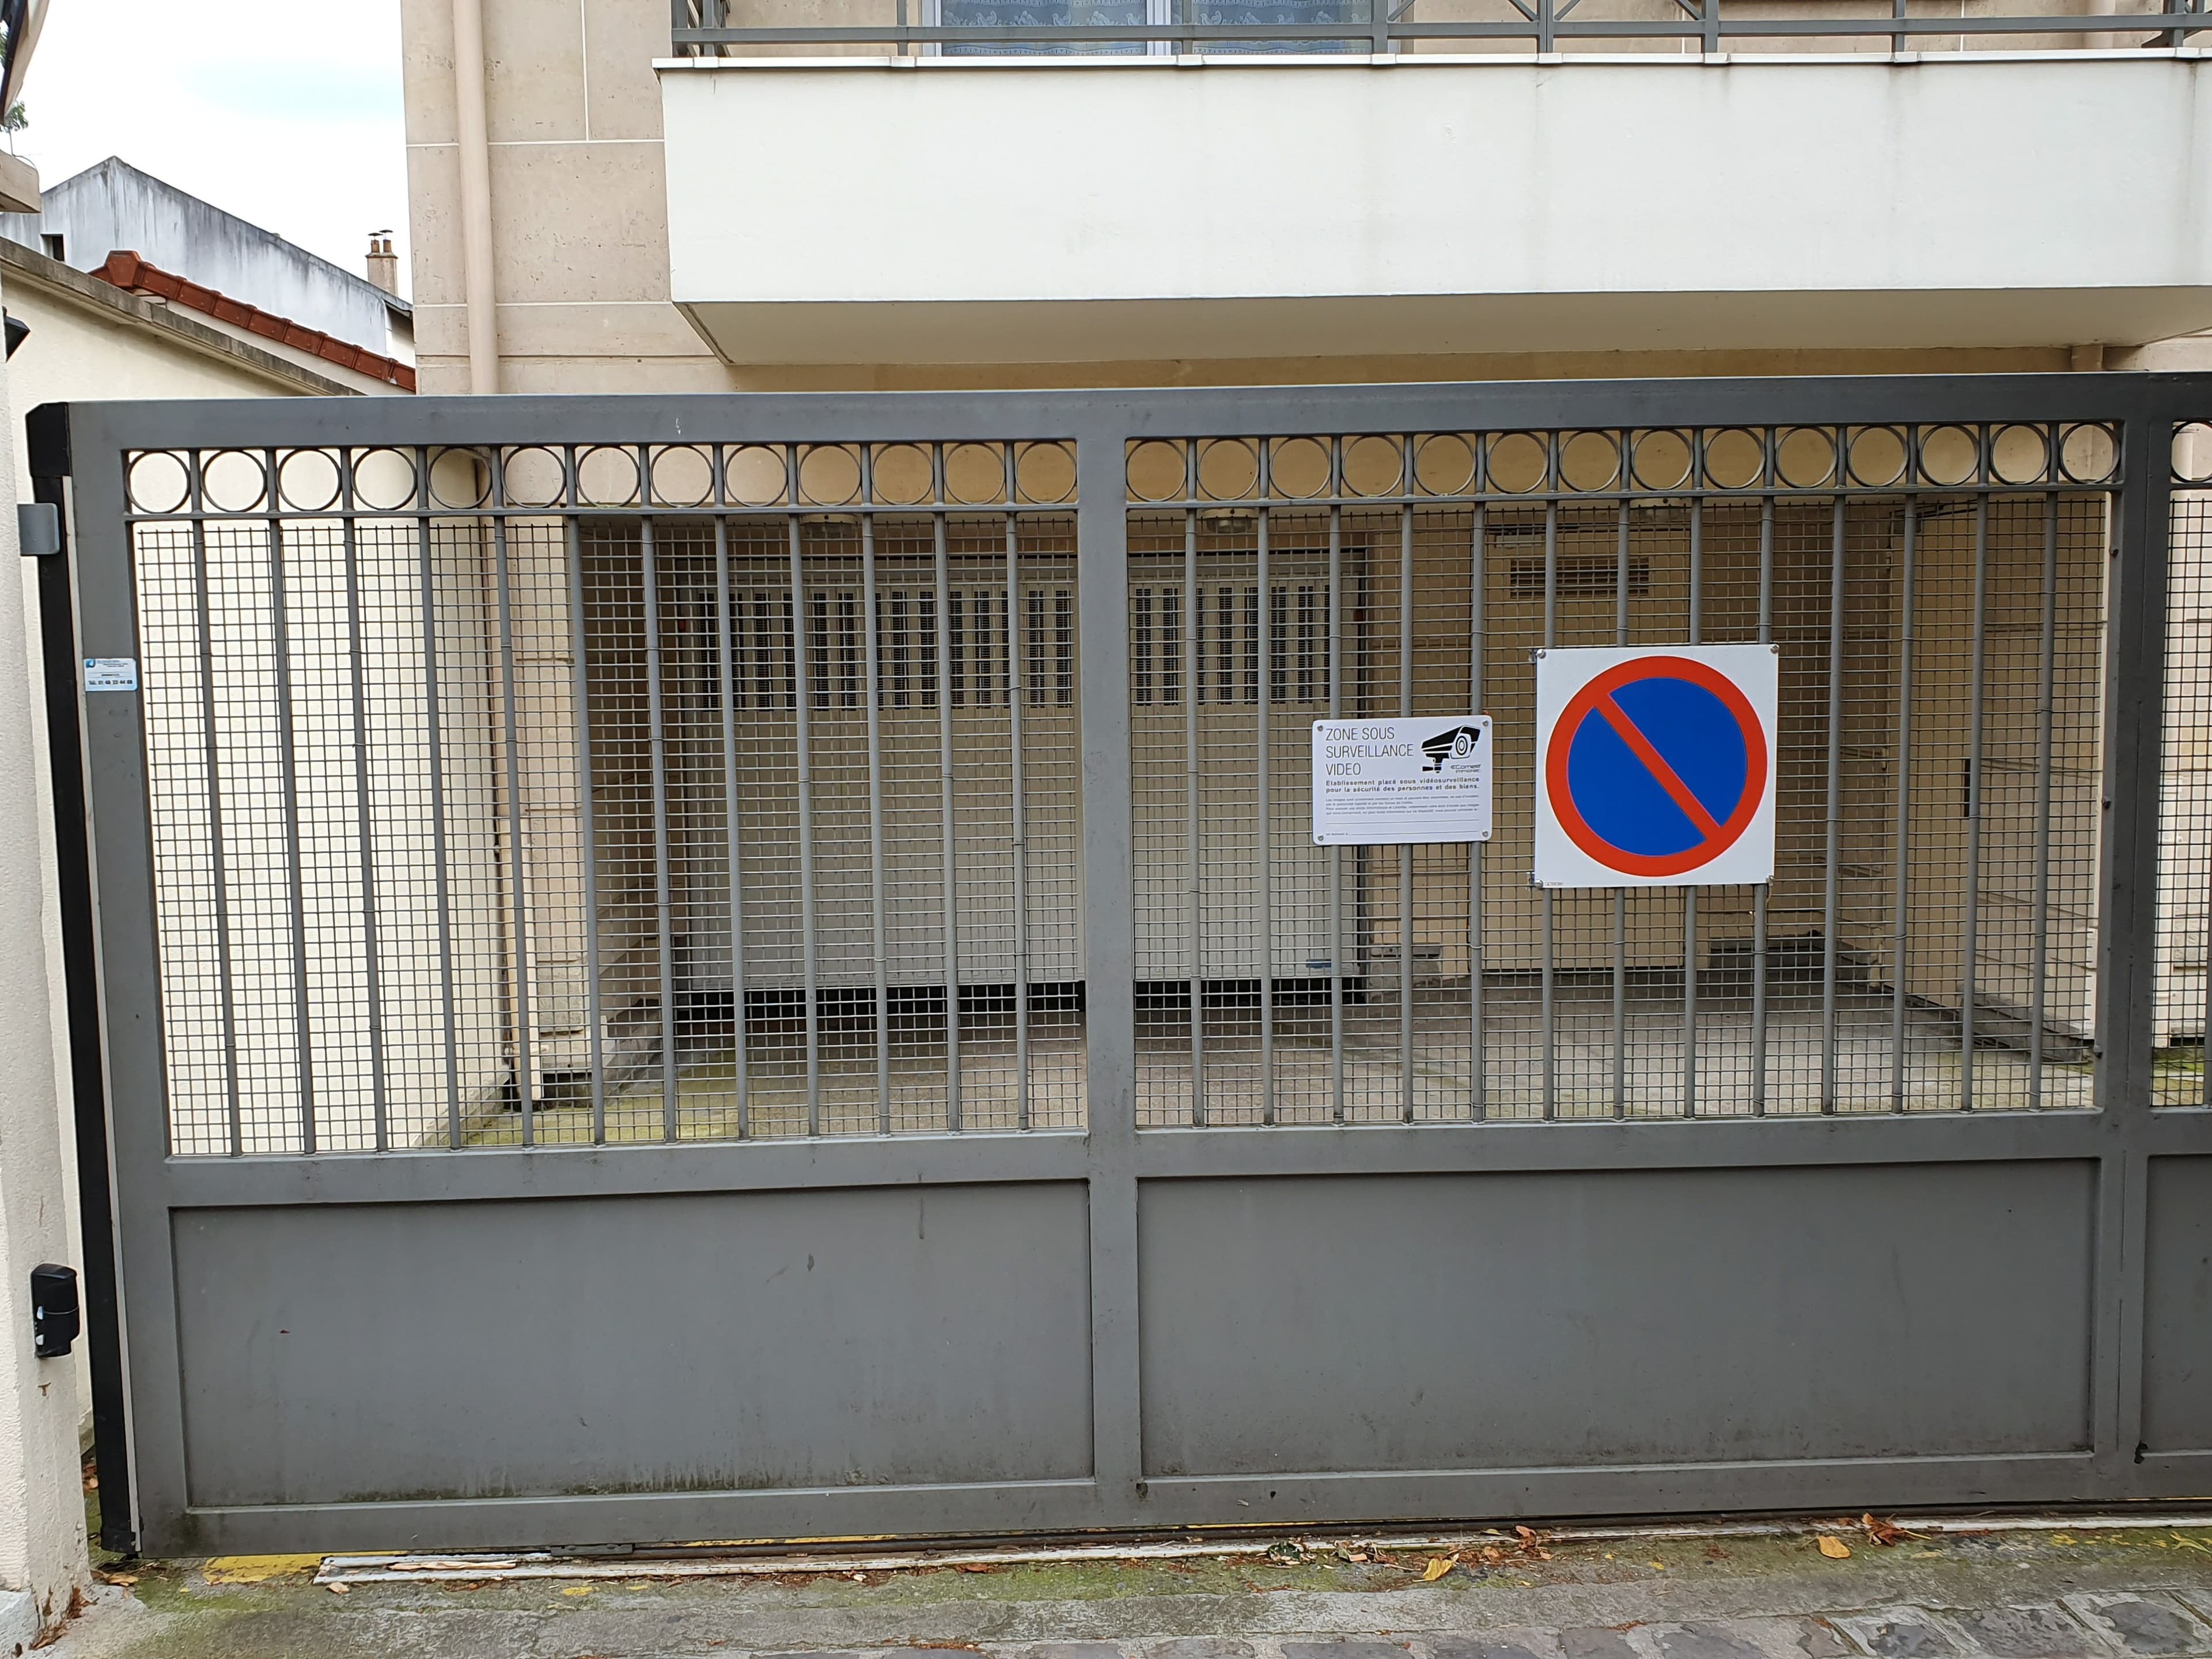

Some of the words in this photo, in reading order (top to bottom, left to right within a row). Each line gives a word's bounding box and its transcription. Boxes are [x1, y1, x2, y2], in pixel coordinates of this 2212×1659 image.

[1325, 728, 1358, 741] ZONE
[1362, 726, 1395, 740] SOUS
[1325, 744, 1414, 759] SURVEILLANCE
[1325, 762, 1361, 776] VIDEO
